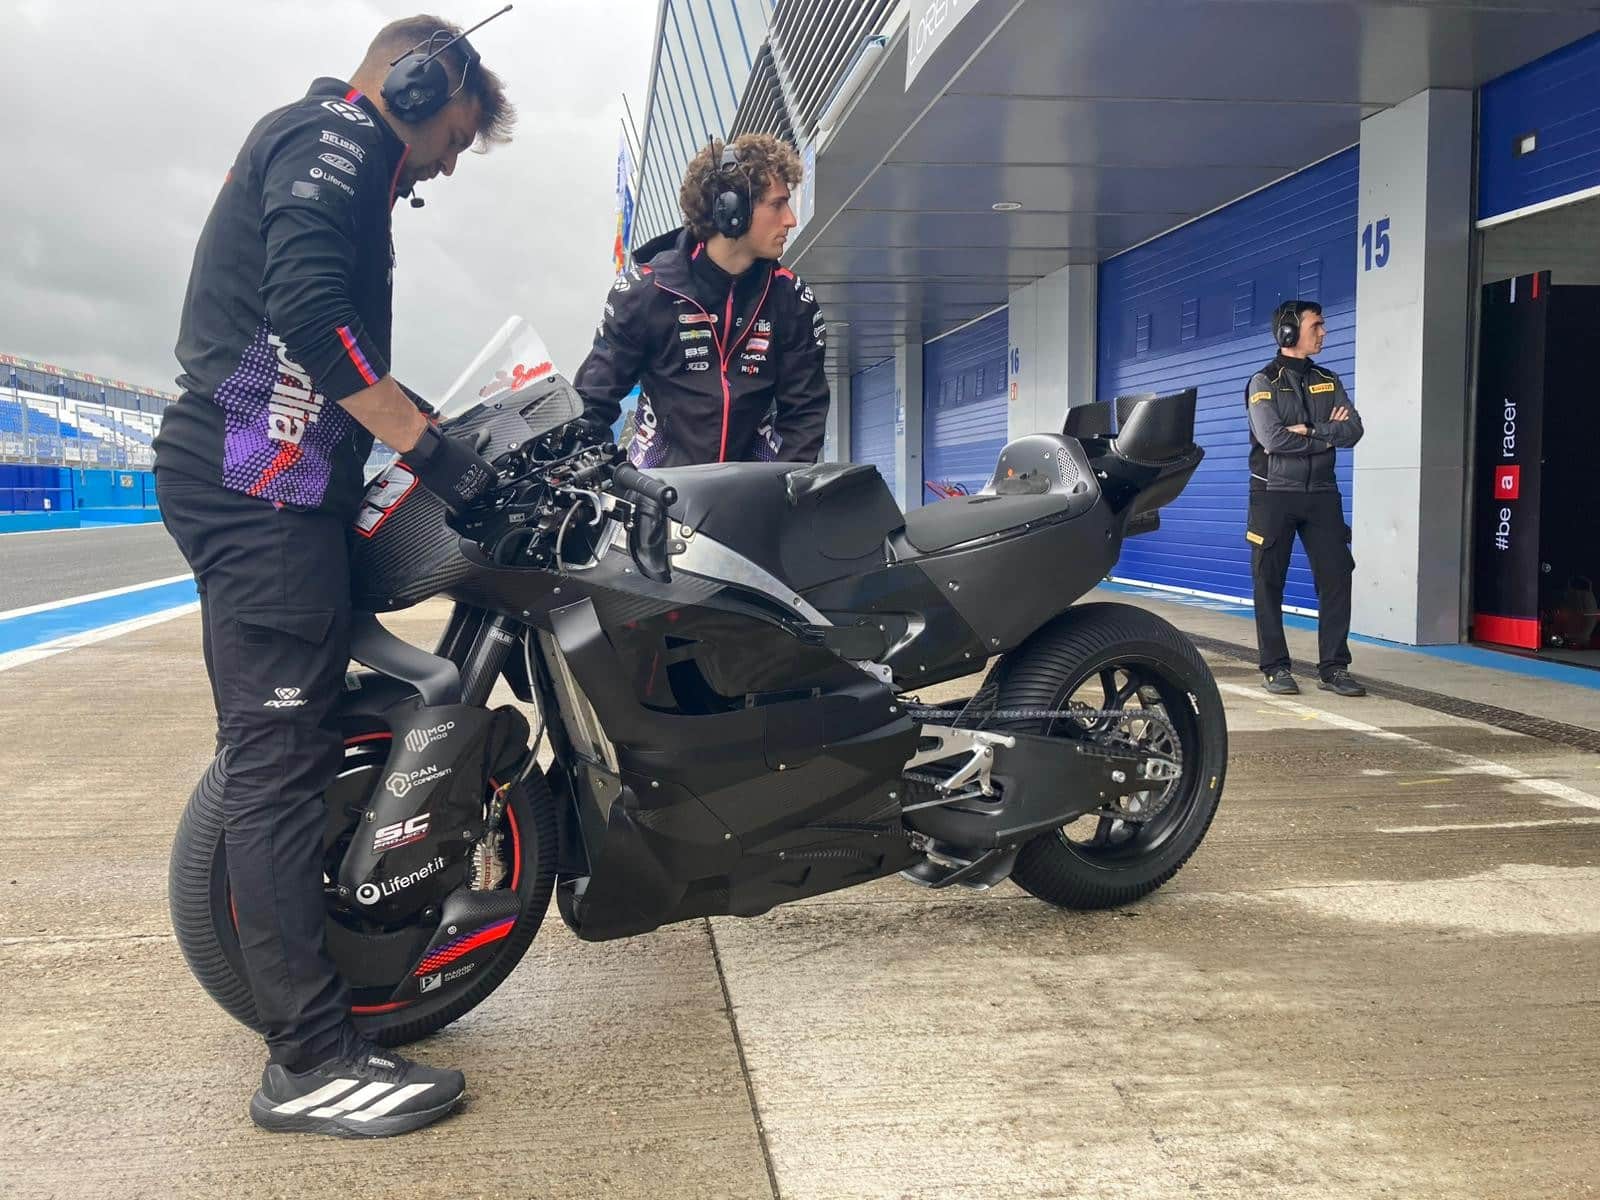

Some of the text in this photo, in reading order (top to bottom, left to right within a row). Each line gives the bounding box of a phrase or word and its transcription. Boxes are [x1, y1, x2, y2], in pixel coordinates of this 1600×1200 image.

[909, 0, 957, 65] LORE
[1361, 217, 1391, 272] 15
[1010, 347, 1020, 375] 16
[1495, 398, 1517, 551] #be a racer
[410, 764, 438, 780] PAN
[374, 812, 431, 845] SC
[380, 857, 445, 896] Lifenet.it
